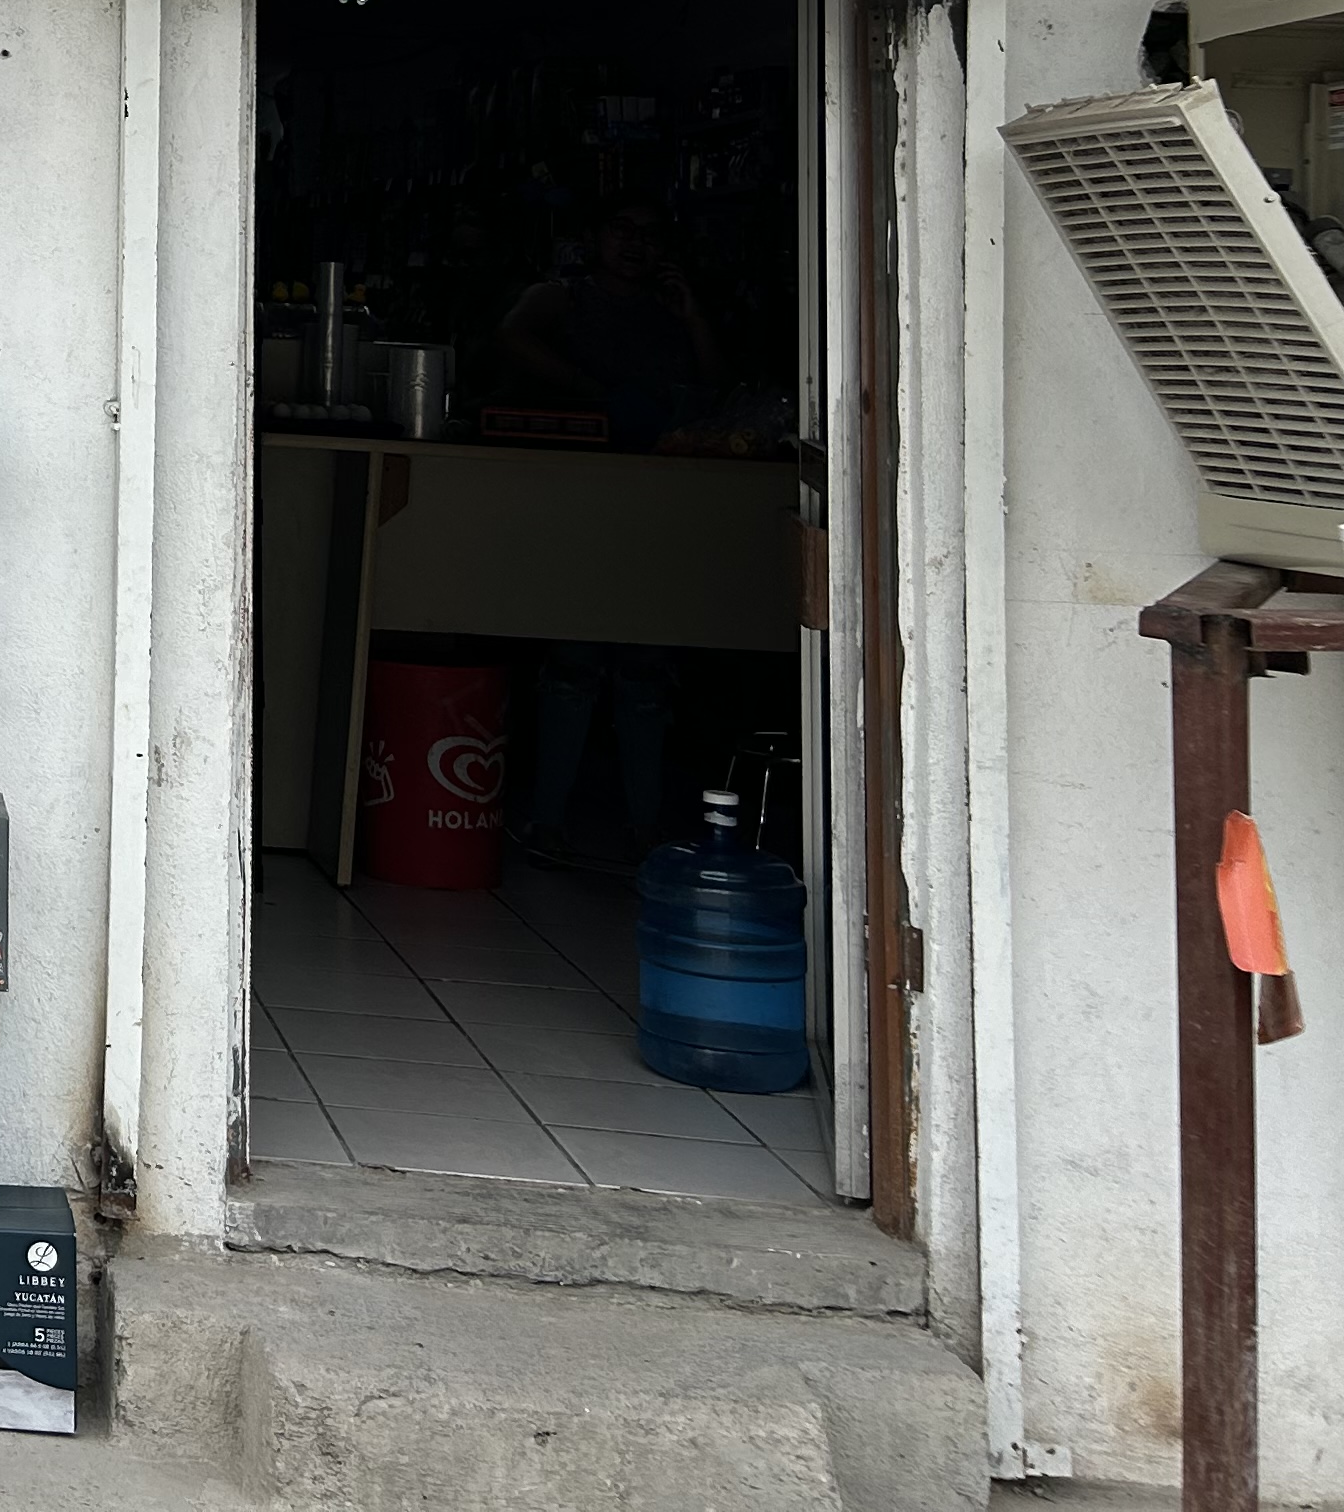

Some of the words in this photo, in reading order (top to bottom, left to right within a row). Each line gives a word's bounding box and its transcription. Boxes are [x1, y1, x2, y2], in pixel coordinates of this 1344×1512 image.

[18, 1274, 65, 1288] LIBBEY
[14, 1291, 65, 1304] YUCATÁN
[34, 1327, 45, 1342] 5
